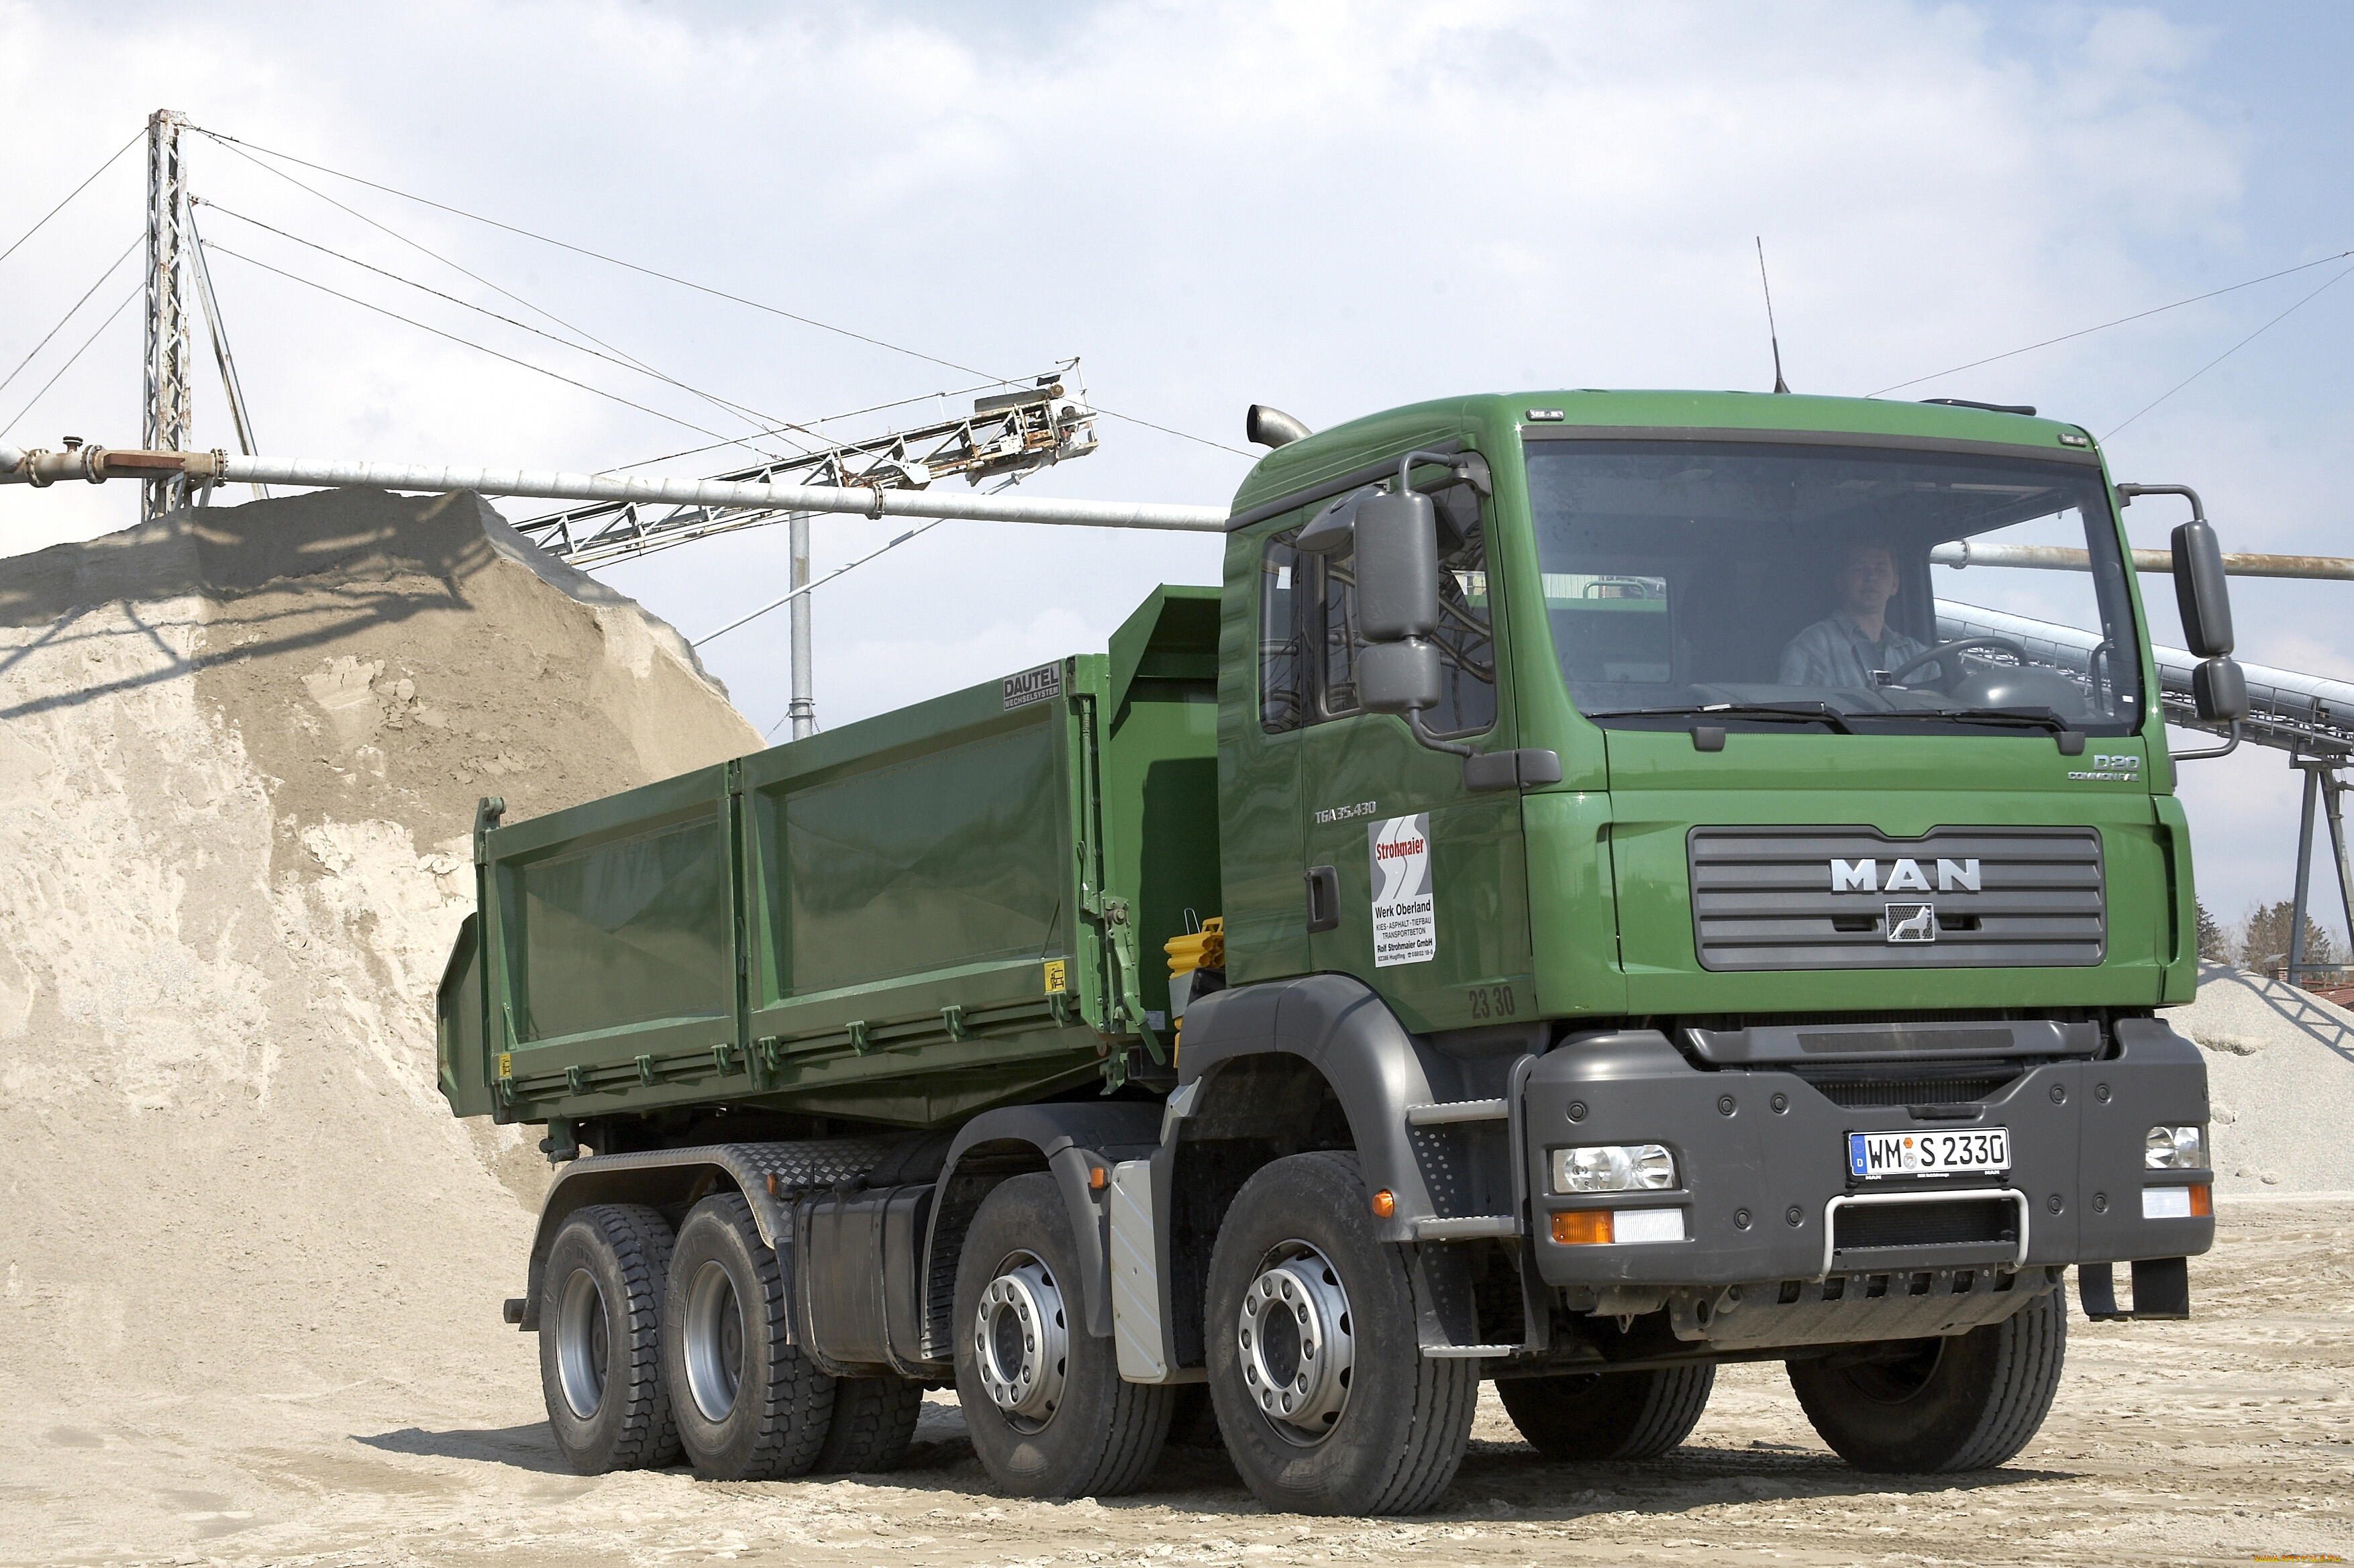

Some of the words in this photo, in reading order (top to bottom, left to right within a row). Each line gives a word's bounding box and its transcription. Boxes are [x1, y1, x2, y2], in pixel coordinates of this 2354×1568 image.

[1005, 668, 1058, 698] DAUTEL
[1005, 686, 1058, 708] WECHSELSYSTEM
[2094, 755, 2140, 772] D20
[1376, 837, 1424, 860] Strohmaier
[1831, 859, 1981, 891] MAN
[1375, 904, 1394, 919] Werk
[1396, 899, 1431, 916] Oberland
[1382, 927, 1426, 939] TRANSPORTBETON
[1377, 944, 1387, 953] Rolf
[1388, 941, 1415, 951] Strohmaier
[1417, 938, 1433, 947] GmbH
[1857, 1158, 1863, 1167] D
[1868, 1139, 1902, 1168] WM
[1921, 1138, 1935, 1166] S
[1943, 1135, 2004, 1165] 2330
